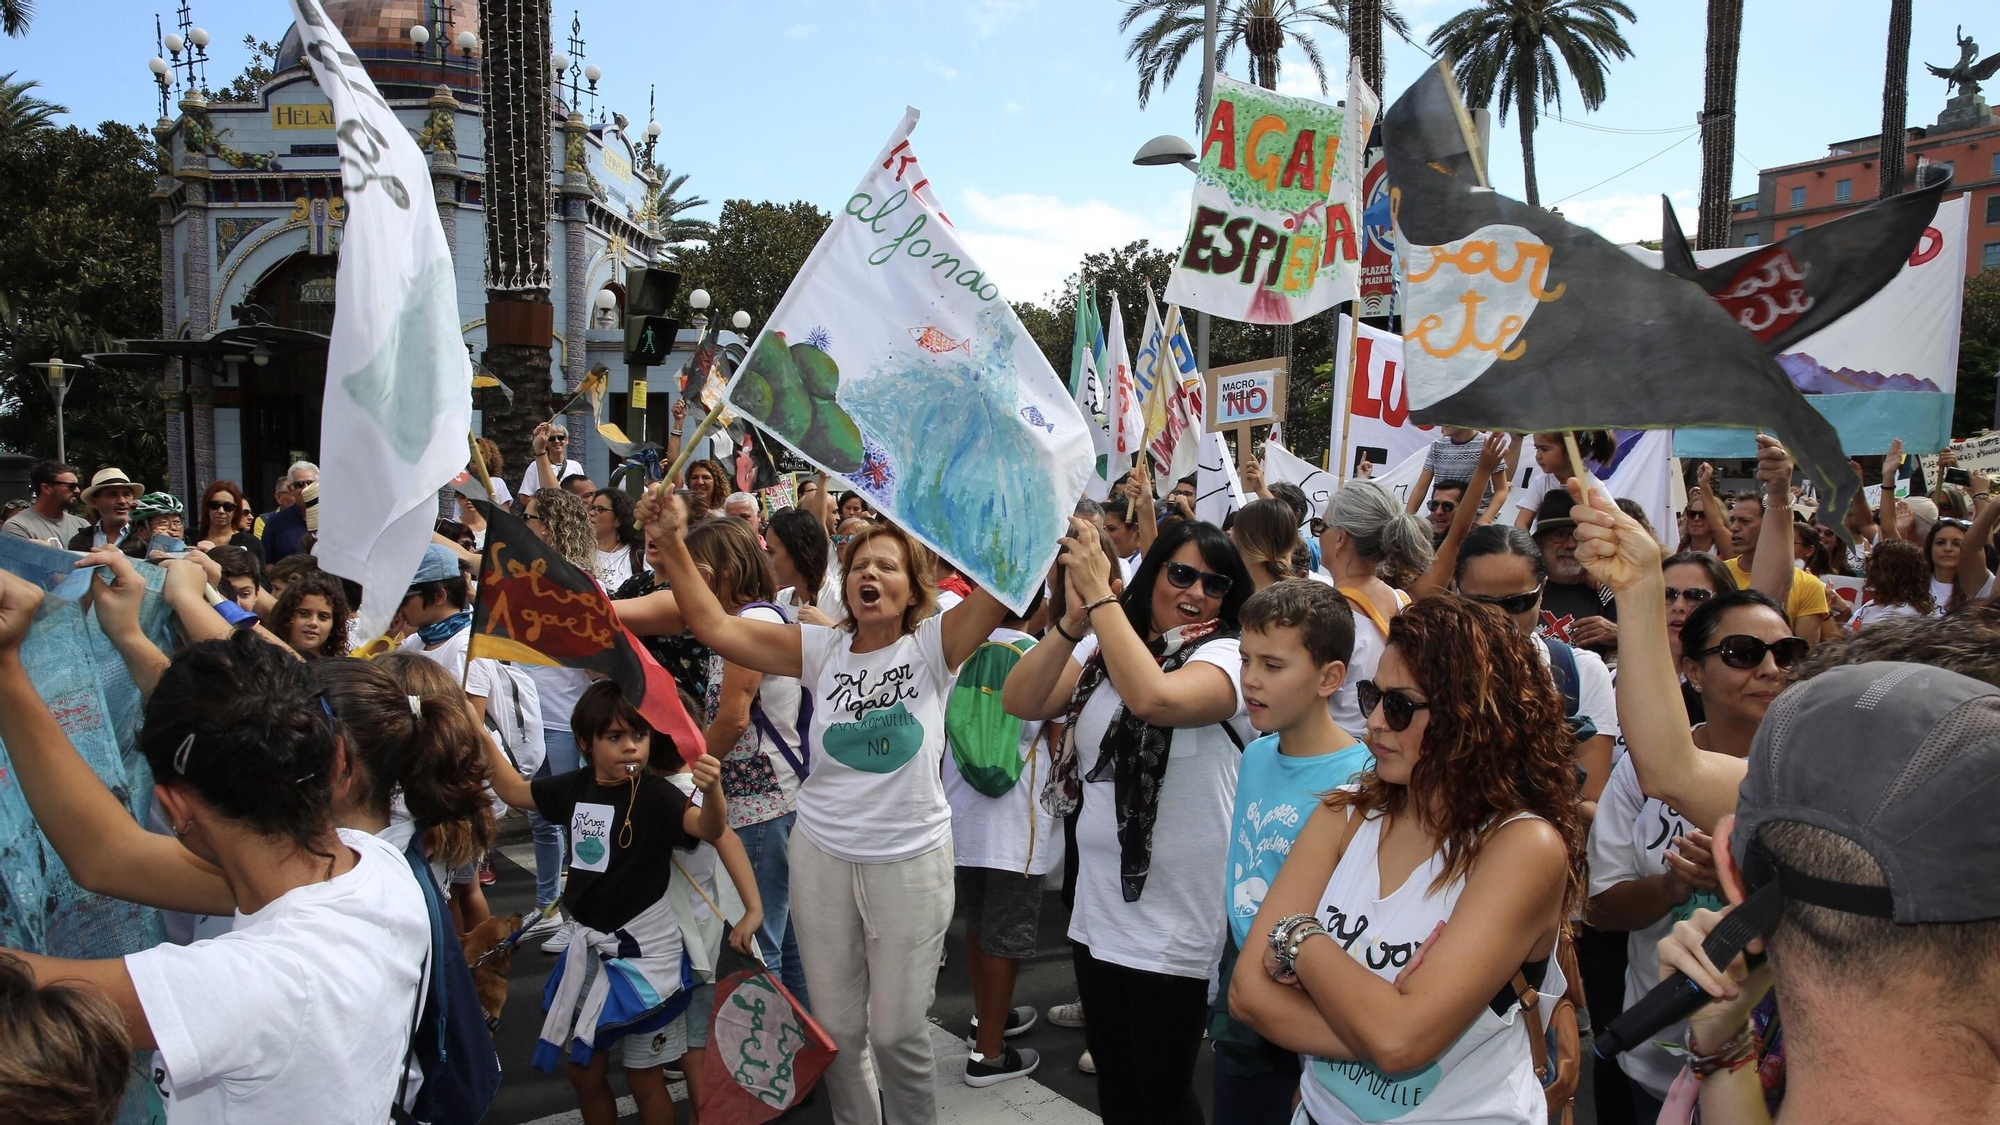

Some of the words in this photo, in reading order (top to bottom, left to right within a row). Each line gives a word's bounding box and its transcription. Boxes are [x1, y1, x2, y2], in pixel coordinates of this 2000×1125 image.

[846, 189, 907, 233] al
[868, 214, 999, 301] fondo
[1361, 265, 1389, 276] PLAZAS
[1365, 277, 1383, 285] PLAZA
[1222, 379, 1256, 392] MACRO
[1227, 387, 1267, 416] NO
[830, 712, 916, 732] MACROMUELLE
[868, 737, 890, 756] NO
